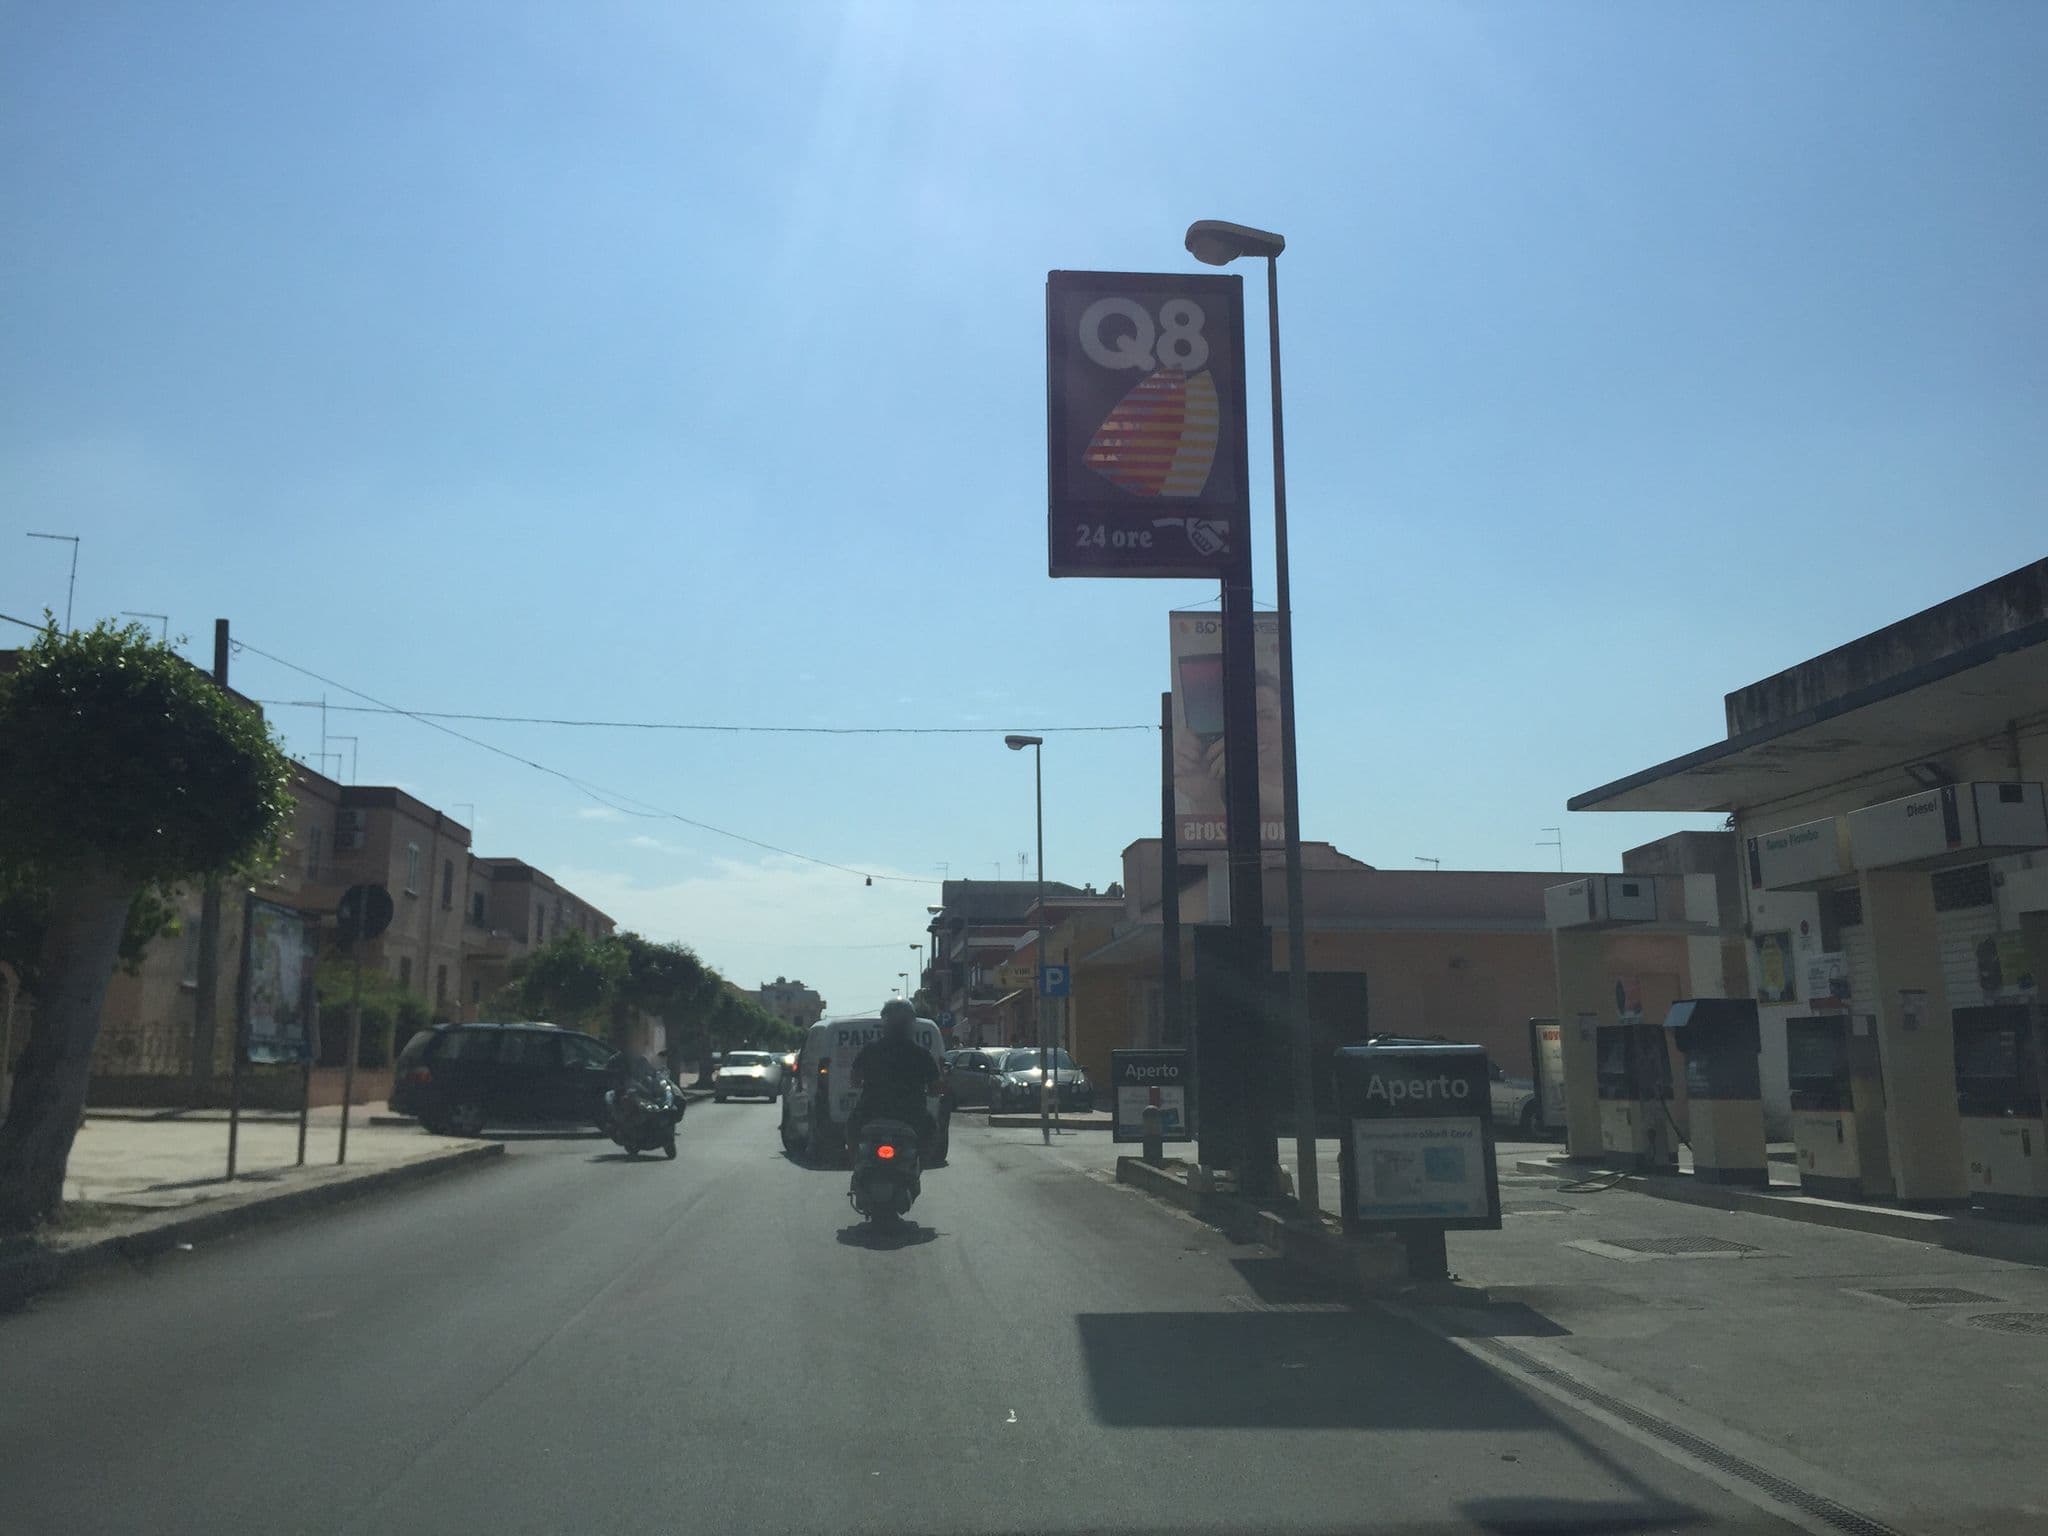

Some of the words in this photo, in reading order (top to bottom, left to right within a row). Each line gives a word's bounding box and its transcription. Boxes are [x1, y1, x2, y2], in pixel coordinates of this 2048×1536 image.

[1079, 297, 1210, 374] Q8
[1076, 523, 1106, 549] 24
[1112, 527, 1153, 549] ore
[1906, 797, 1937, 818] Diesel
[1046, 968, 1063, 993] P
[1125, 1063, 1179, 1081] Aperto
[1366, 1073, 1469, 1106] Aperto
